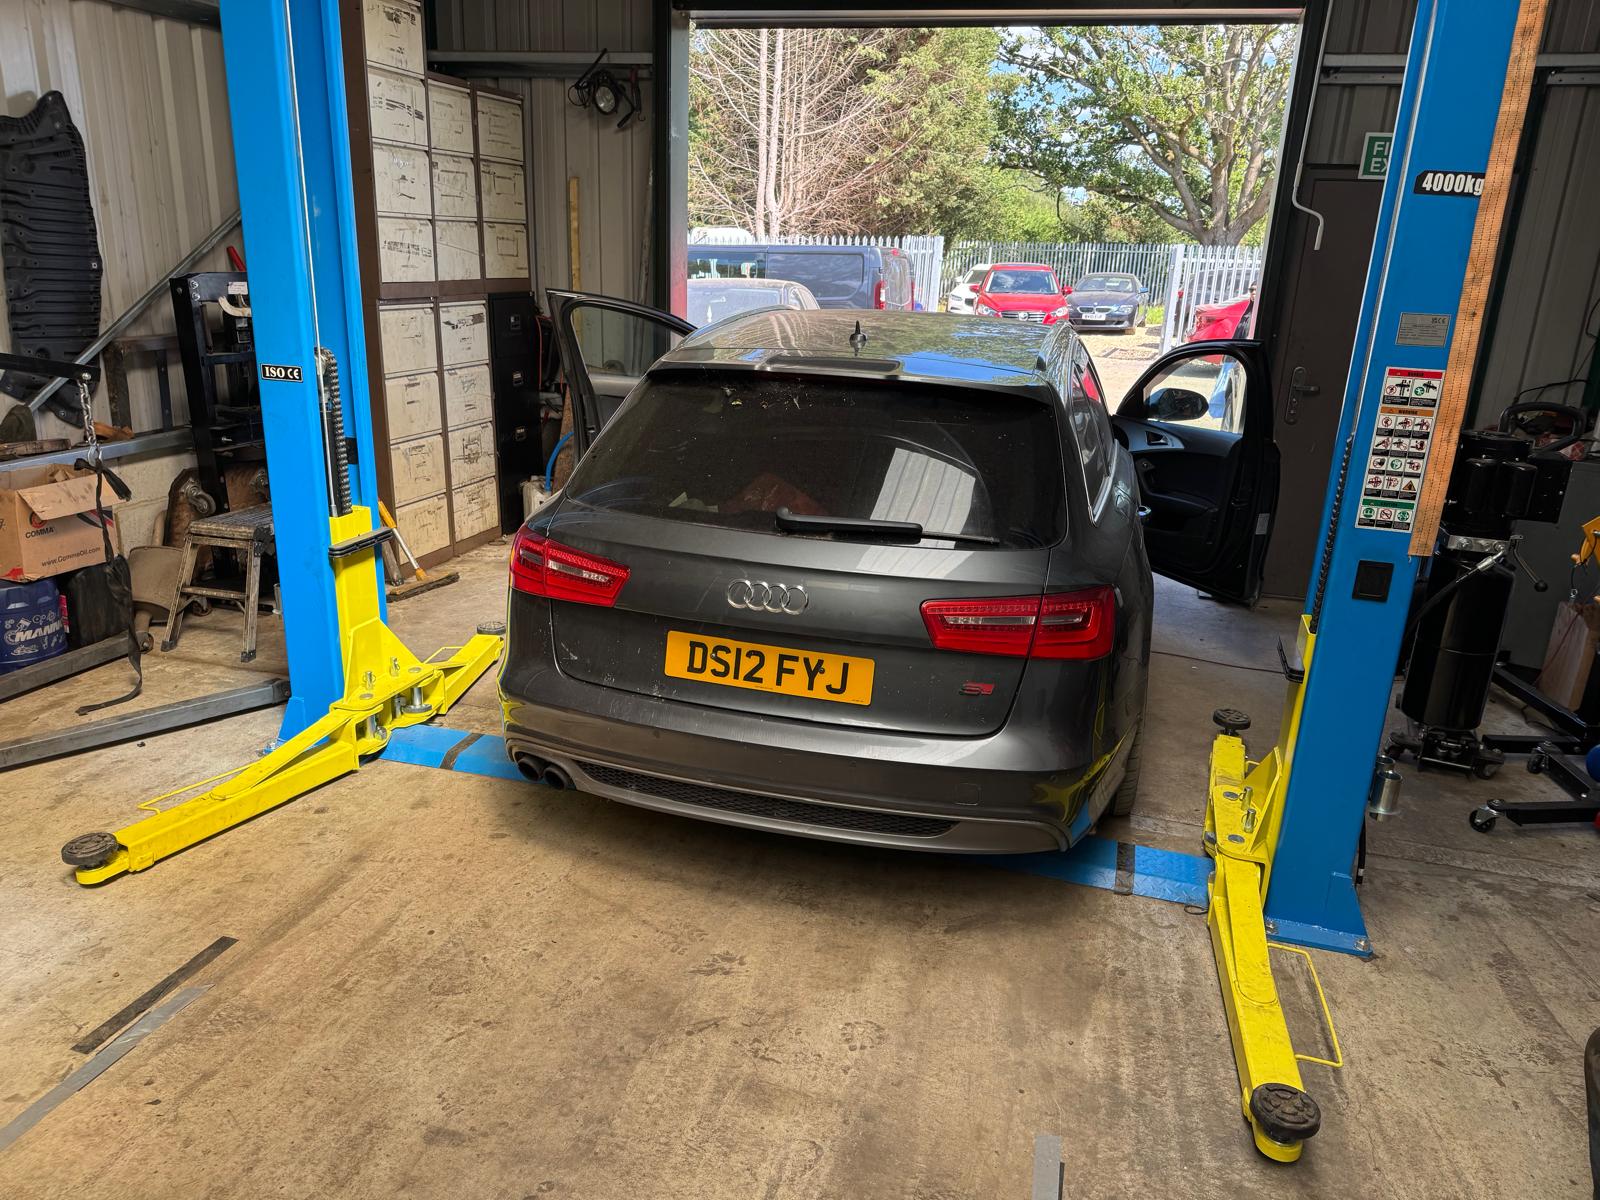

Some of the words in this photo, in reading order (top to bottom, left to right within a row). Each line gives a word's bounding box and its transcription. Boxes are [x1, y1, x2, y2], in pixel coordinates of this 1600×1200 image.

[1373, 141, 1392, 156] FI
[1370, 157, 1389, 173] EX
[1421, 172, 1485, 196] 4000kg
[264, 366, 286, 378] ISO
[25, 527, 54, 539] COMMA
[686, 640, 766, 684] DS12
[775, 653, 850, 695] FYJ
